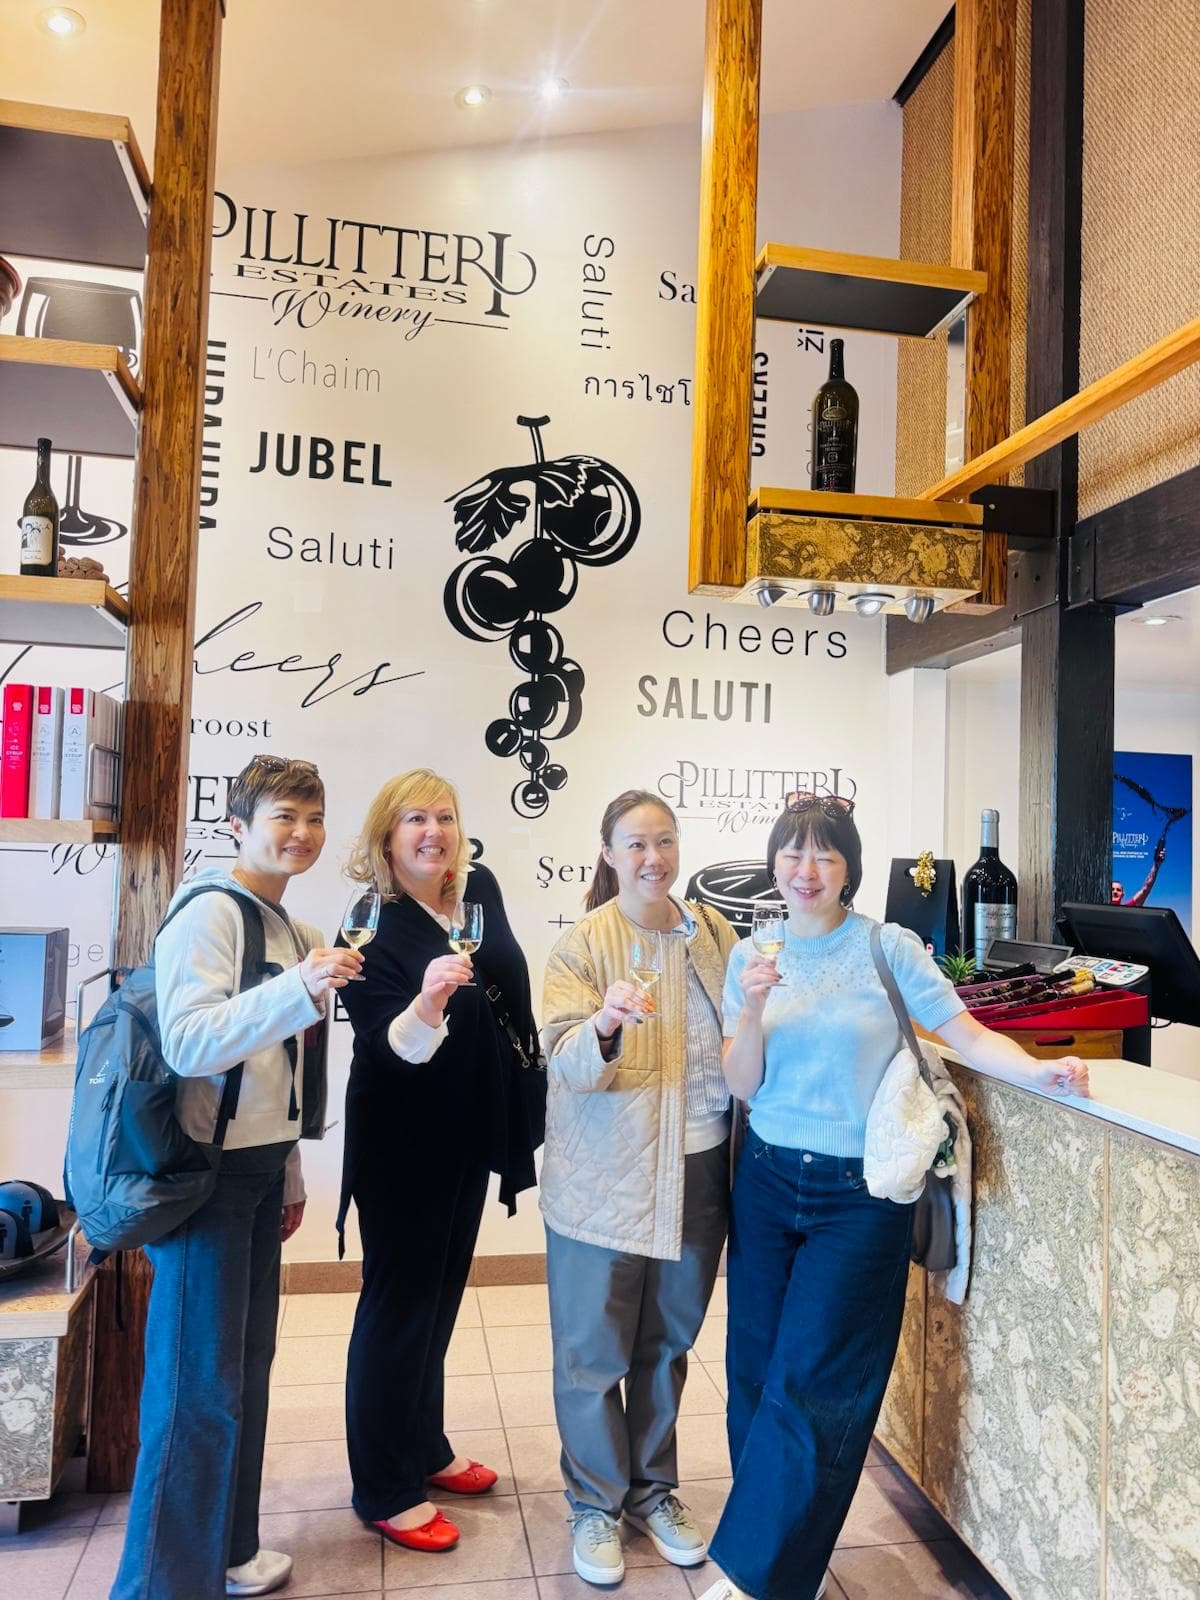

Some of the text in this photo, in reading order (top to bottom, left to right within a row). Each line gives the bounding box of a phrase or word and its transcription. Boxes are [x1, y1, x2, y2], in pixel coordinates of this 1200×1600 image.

[233, 264, 468, 305] ESTATES
[580, 235, 615, 350] Saluti
[658, 270, 698, 304] Sa
[270, 288, 436, 341] Winery
[252, 346, 381, 393] L'Chaim
[249, 431, 392, 488] JUBEL
[266, 526, 394, 570] Saluti
[662, 609, 848, 659] Cheers
[637, 674, 772, 724] SALUTI
[657, 760, 857, 809] PILLITTERI
